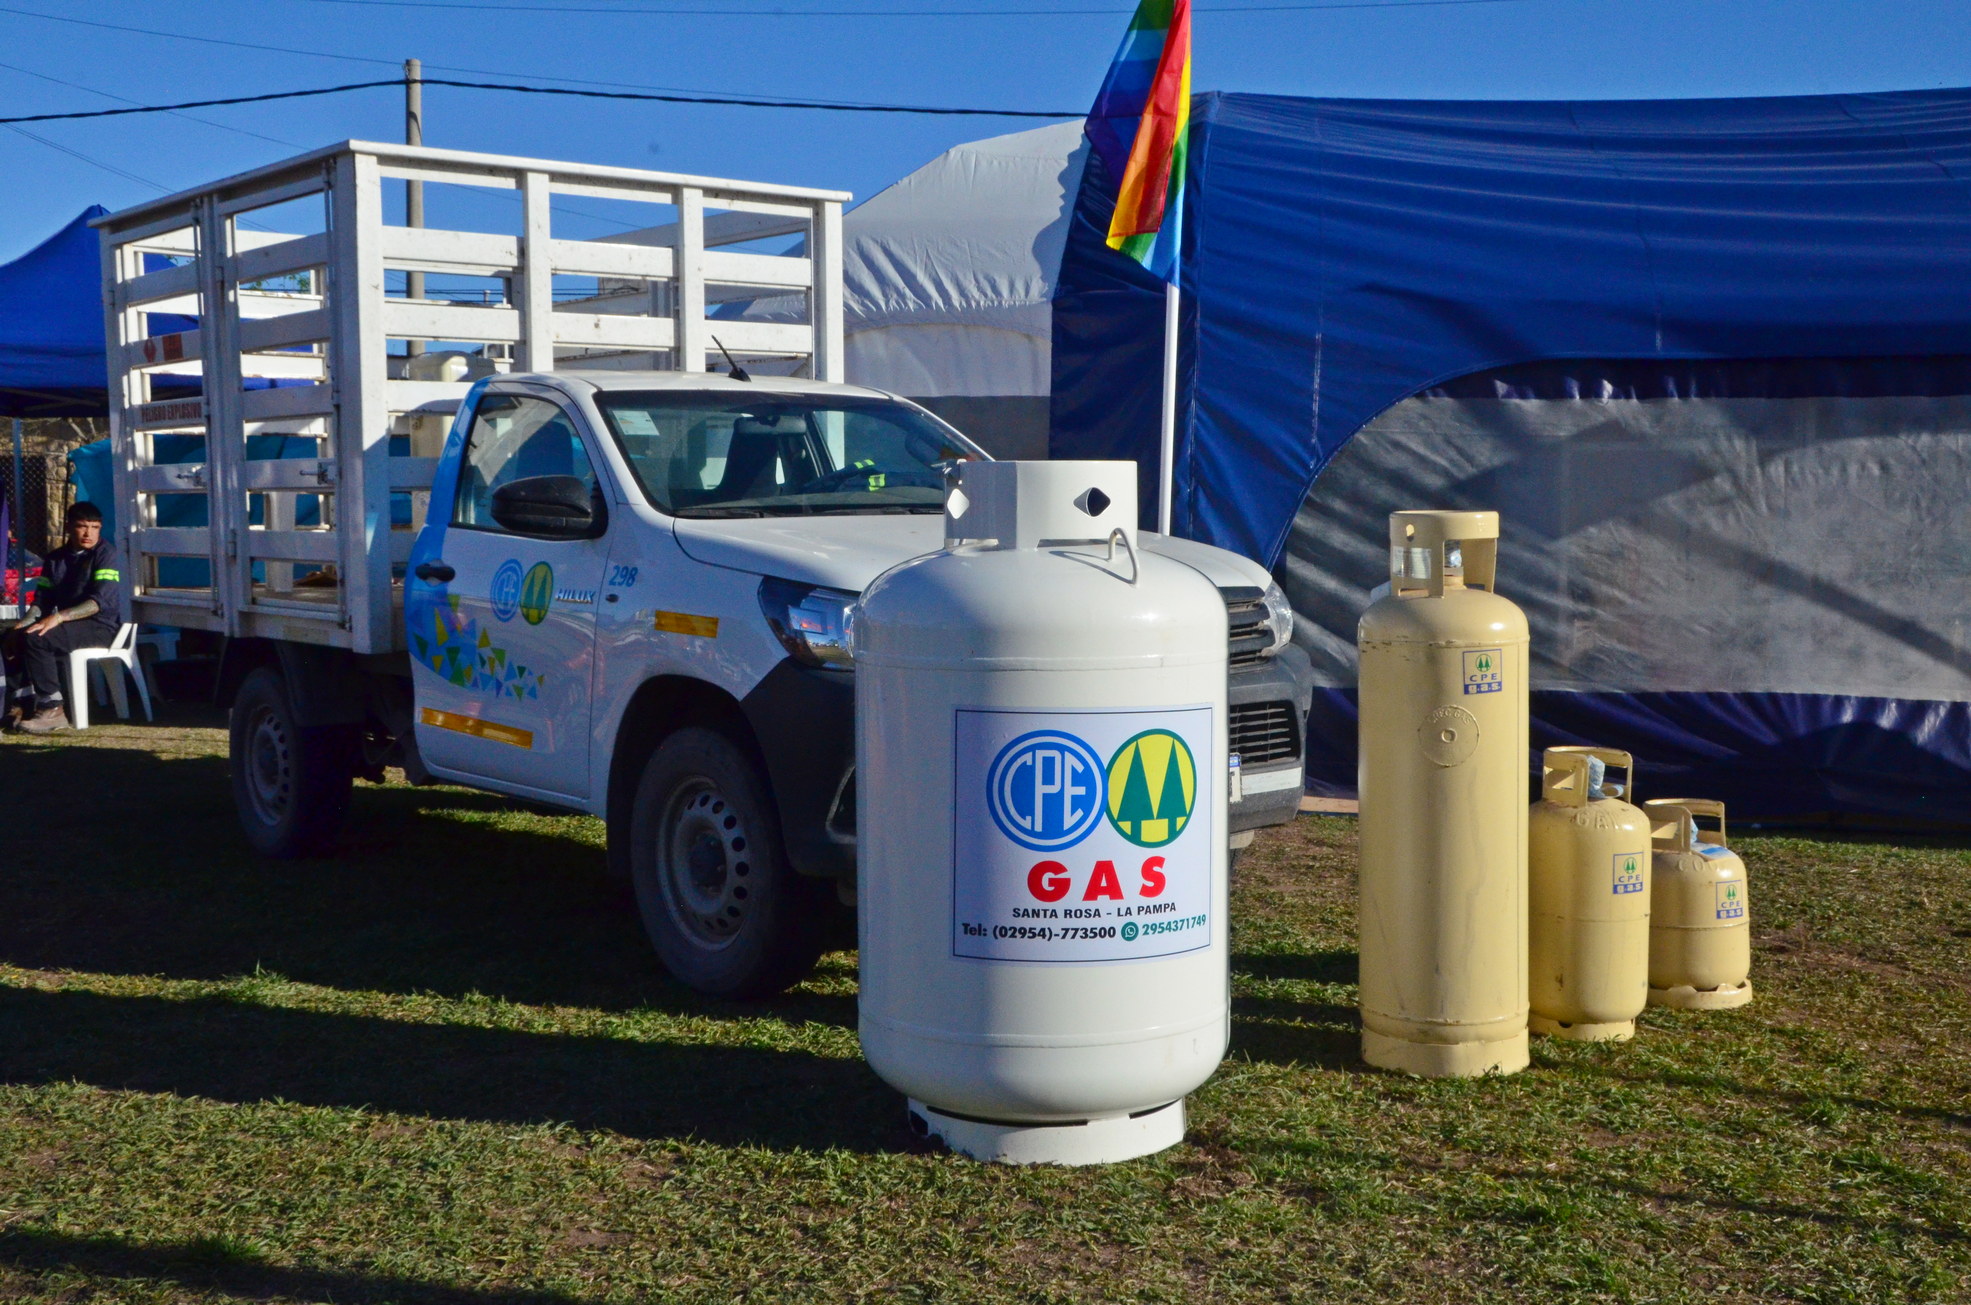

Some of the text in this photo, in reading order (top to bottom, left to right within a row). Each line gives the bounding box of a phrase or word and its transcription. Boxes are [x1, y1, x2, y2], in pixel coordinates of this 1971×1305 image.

[608, 565, 638, 587] 298
[555, 588, 596, 604] HILUX
[1469, 672, 1498, 682] CPE
[1003, 749, 1086, 832] CPE
[1027, 855, 1167, 903] GAS
[1618, 874, 1641, 883] CPE
[1012, 908, 1059, 919] SANTA
[1064, 907, 1101, 918] ROSA
[1117, 906, 1133, 917] LA
[1137, 902, 1177, 916] PAMPA
[962, 914, 1206, 941] Tel: (02954)-773500 2954371749
